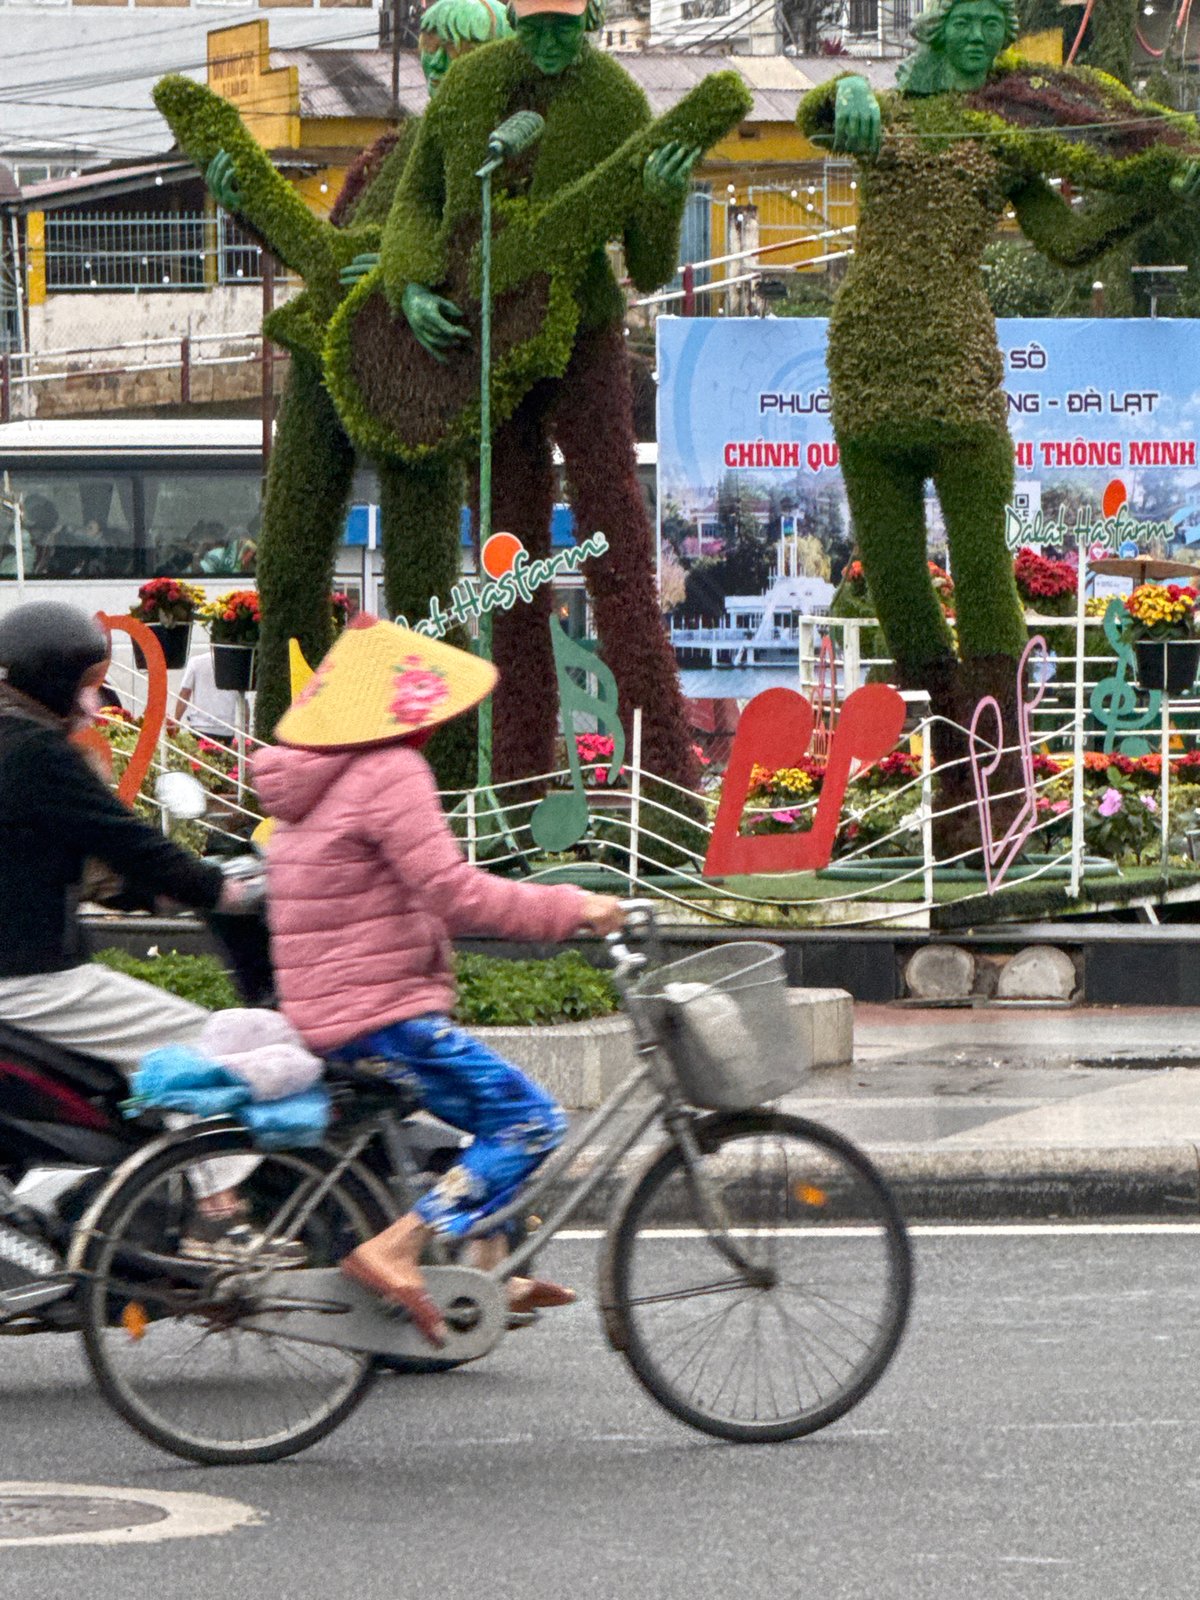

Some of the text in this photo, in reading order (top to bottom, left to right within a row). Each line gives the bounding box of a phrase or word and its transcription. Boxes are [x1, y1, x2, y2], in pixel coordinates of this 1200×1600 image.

[1067, 388, 1102, 413] ĐÀ
[1110, 393, 1159, 416] LẠT
[724, 438, 799, 467] CHÍNH
[1040, 437, 1122, 466] THÔNG
[1129, 442, 1196, 466] MINH
[1005, 502, 1175, 552] Dalat Hasfarm
[450, 538, 609, 624] Hasfarm
